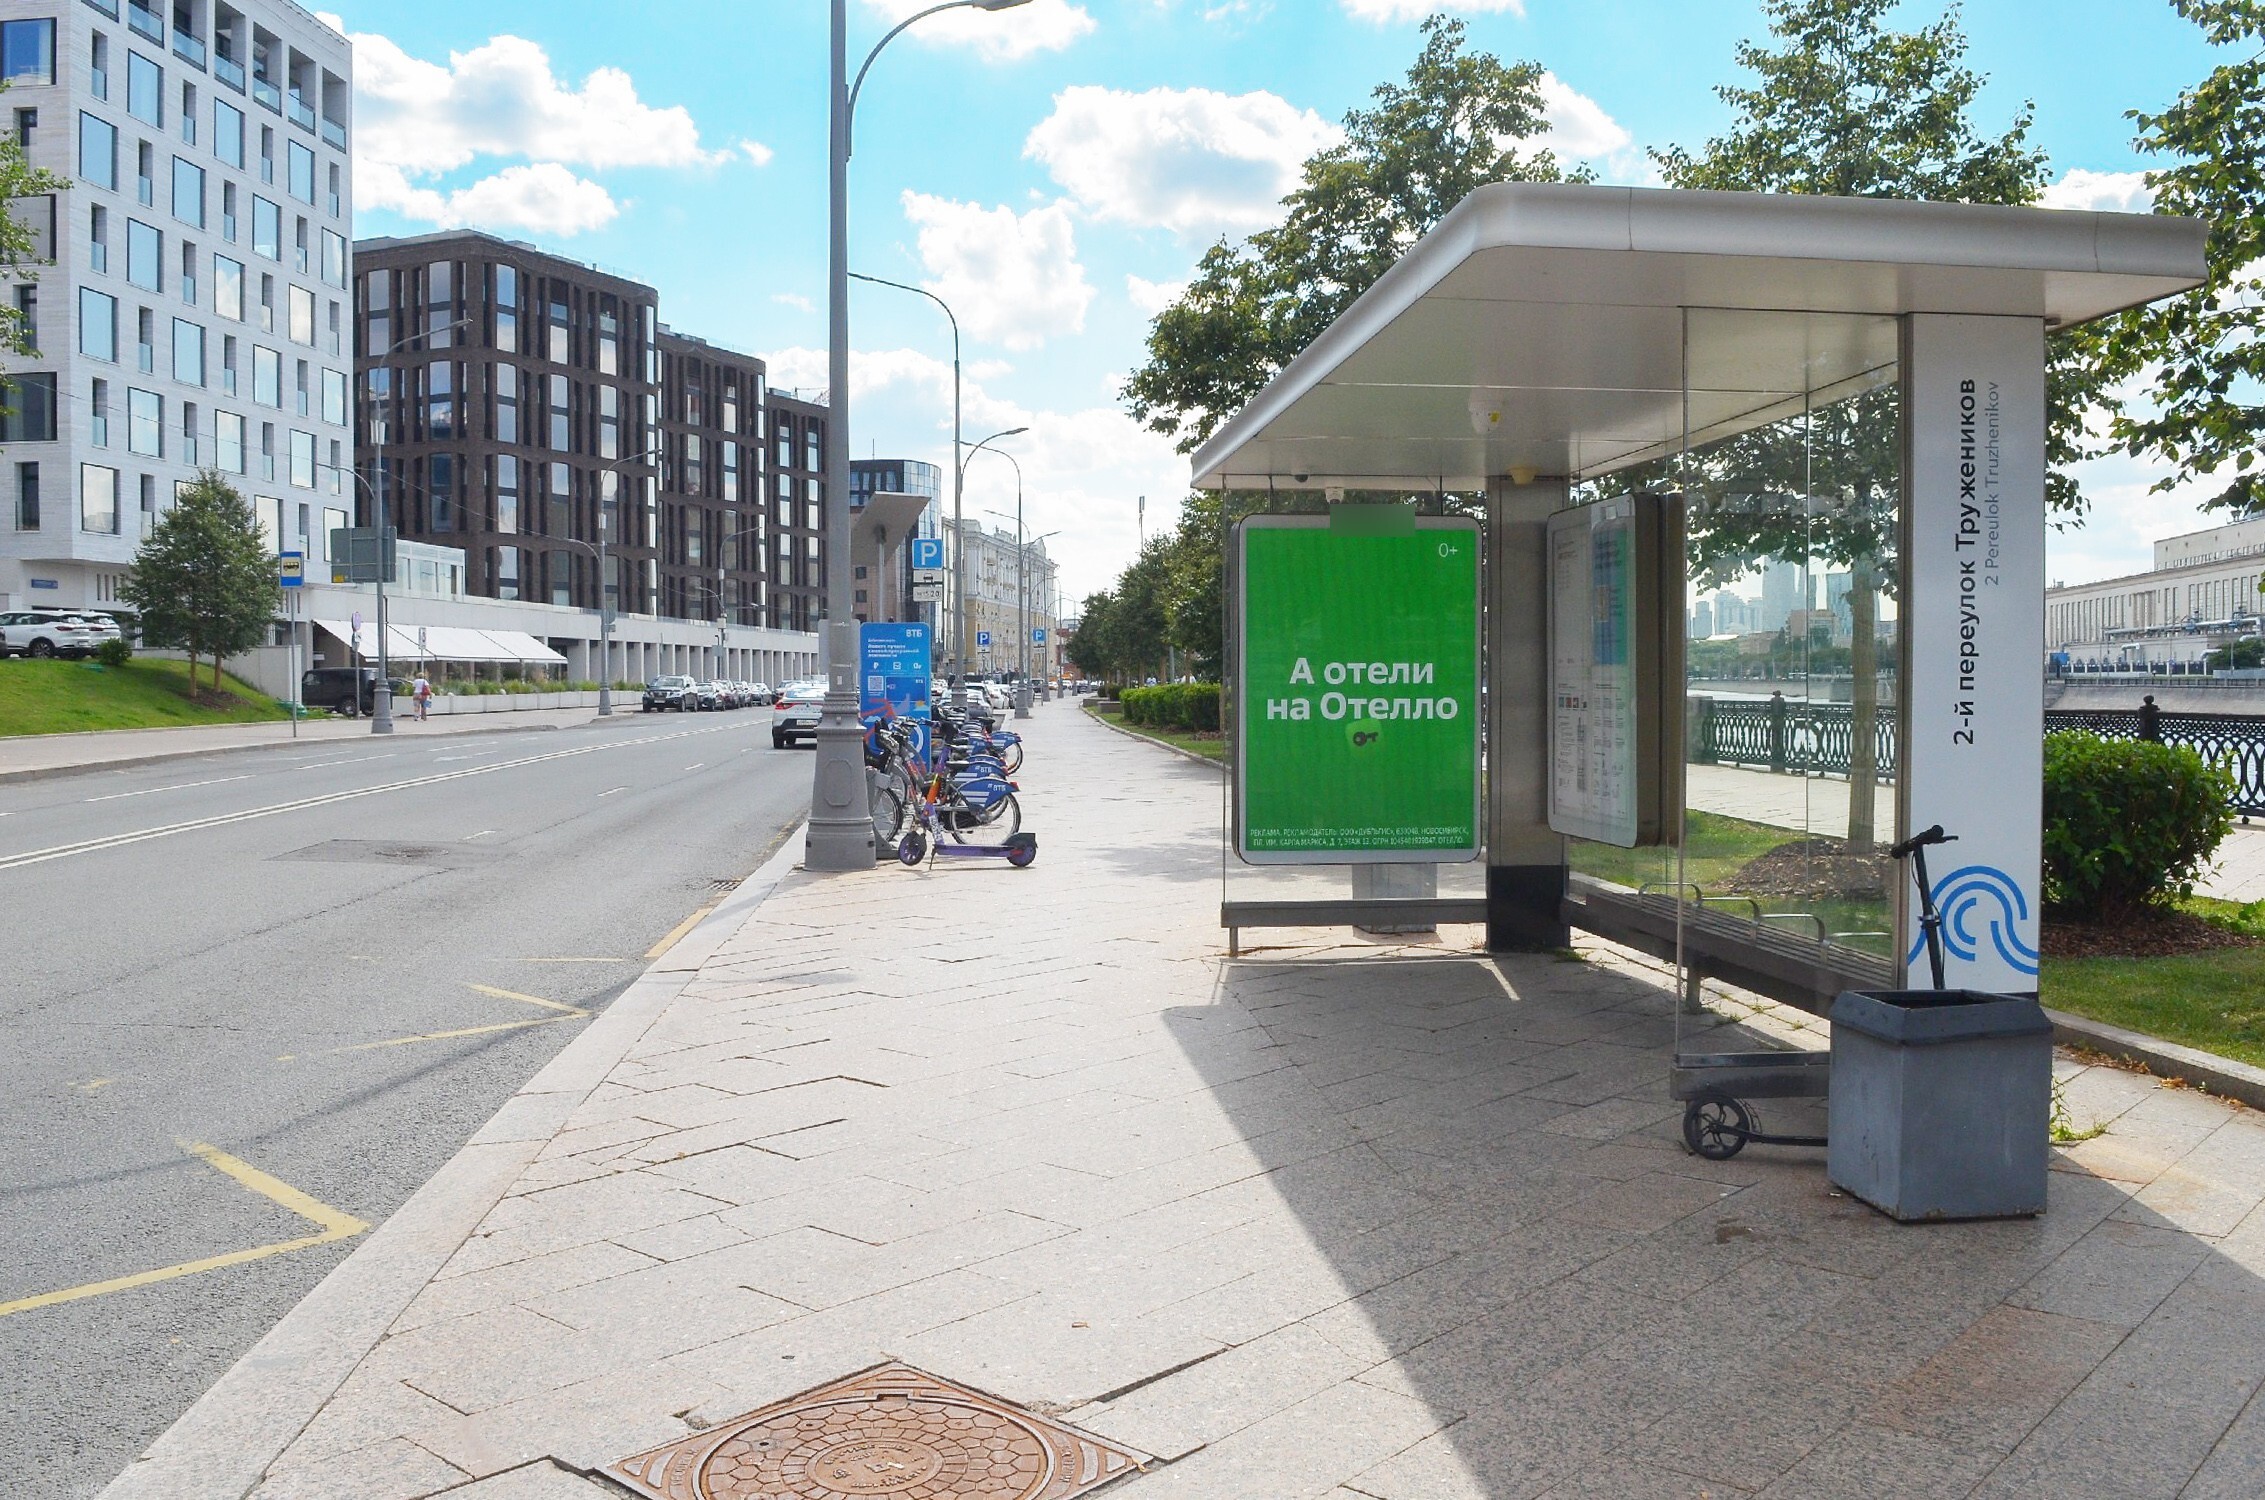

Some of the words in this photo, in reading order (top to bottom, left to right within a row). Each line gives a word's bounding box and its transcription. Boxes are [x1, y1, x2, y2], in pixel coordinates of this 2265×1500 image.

[1984, 381, 2000, 489] Truzhenikov
[1955, 378, 1981, 553] Тружеников
[1984, 493, 1999, 569] Pereulok
[921, 541, 938, 566] P
[1438, 543, 1459, 558] 0+
[1984, 575, 2000, 586] 2
[905, 629, 923, 638] ВТБ
[980, 633, 988, 645] P
[1958, 560, 1981, 691] переулок
[1289, 657, 1316, 685] А
[1323, 661, 1434, 685] отели
[1267, 697, 1311, 721] на
[1319, 691, 1458, 721] Отелло
[1953, 702, 1976, 746] 2-й
